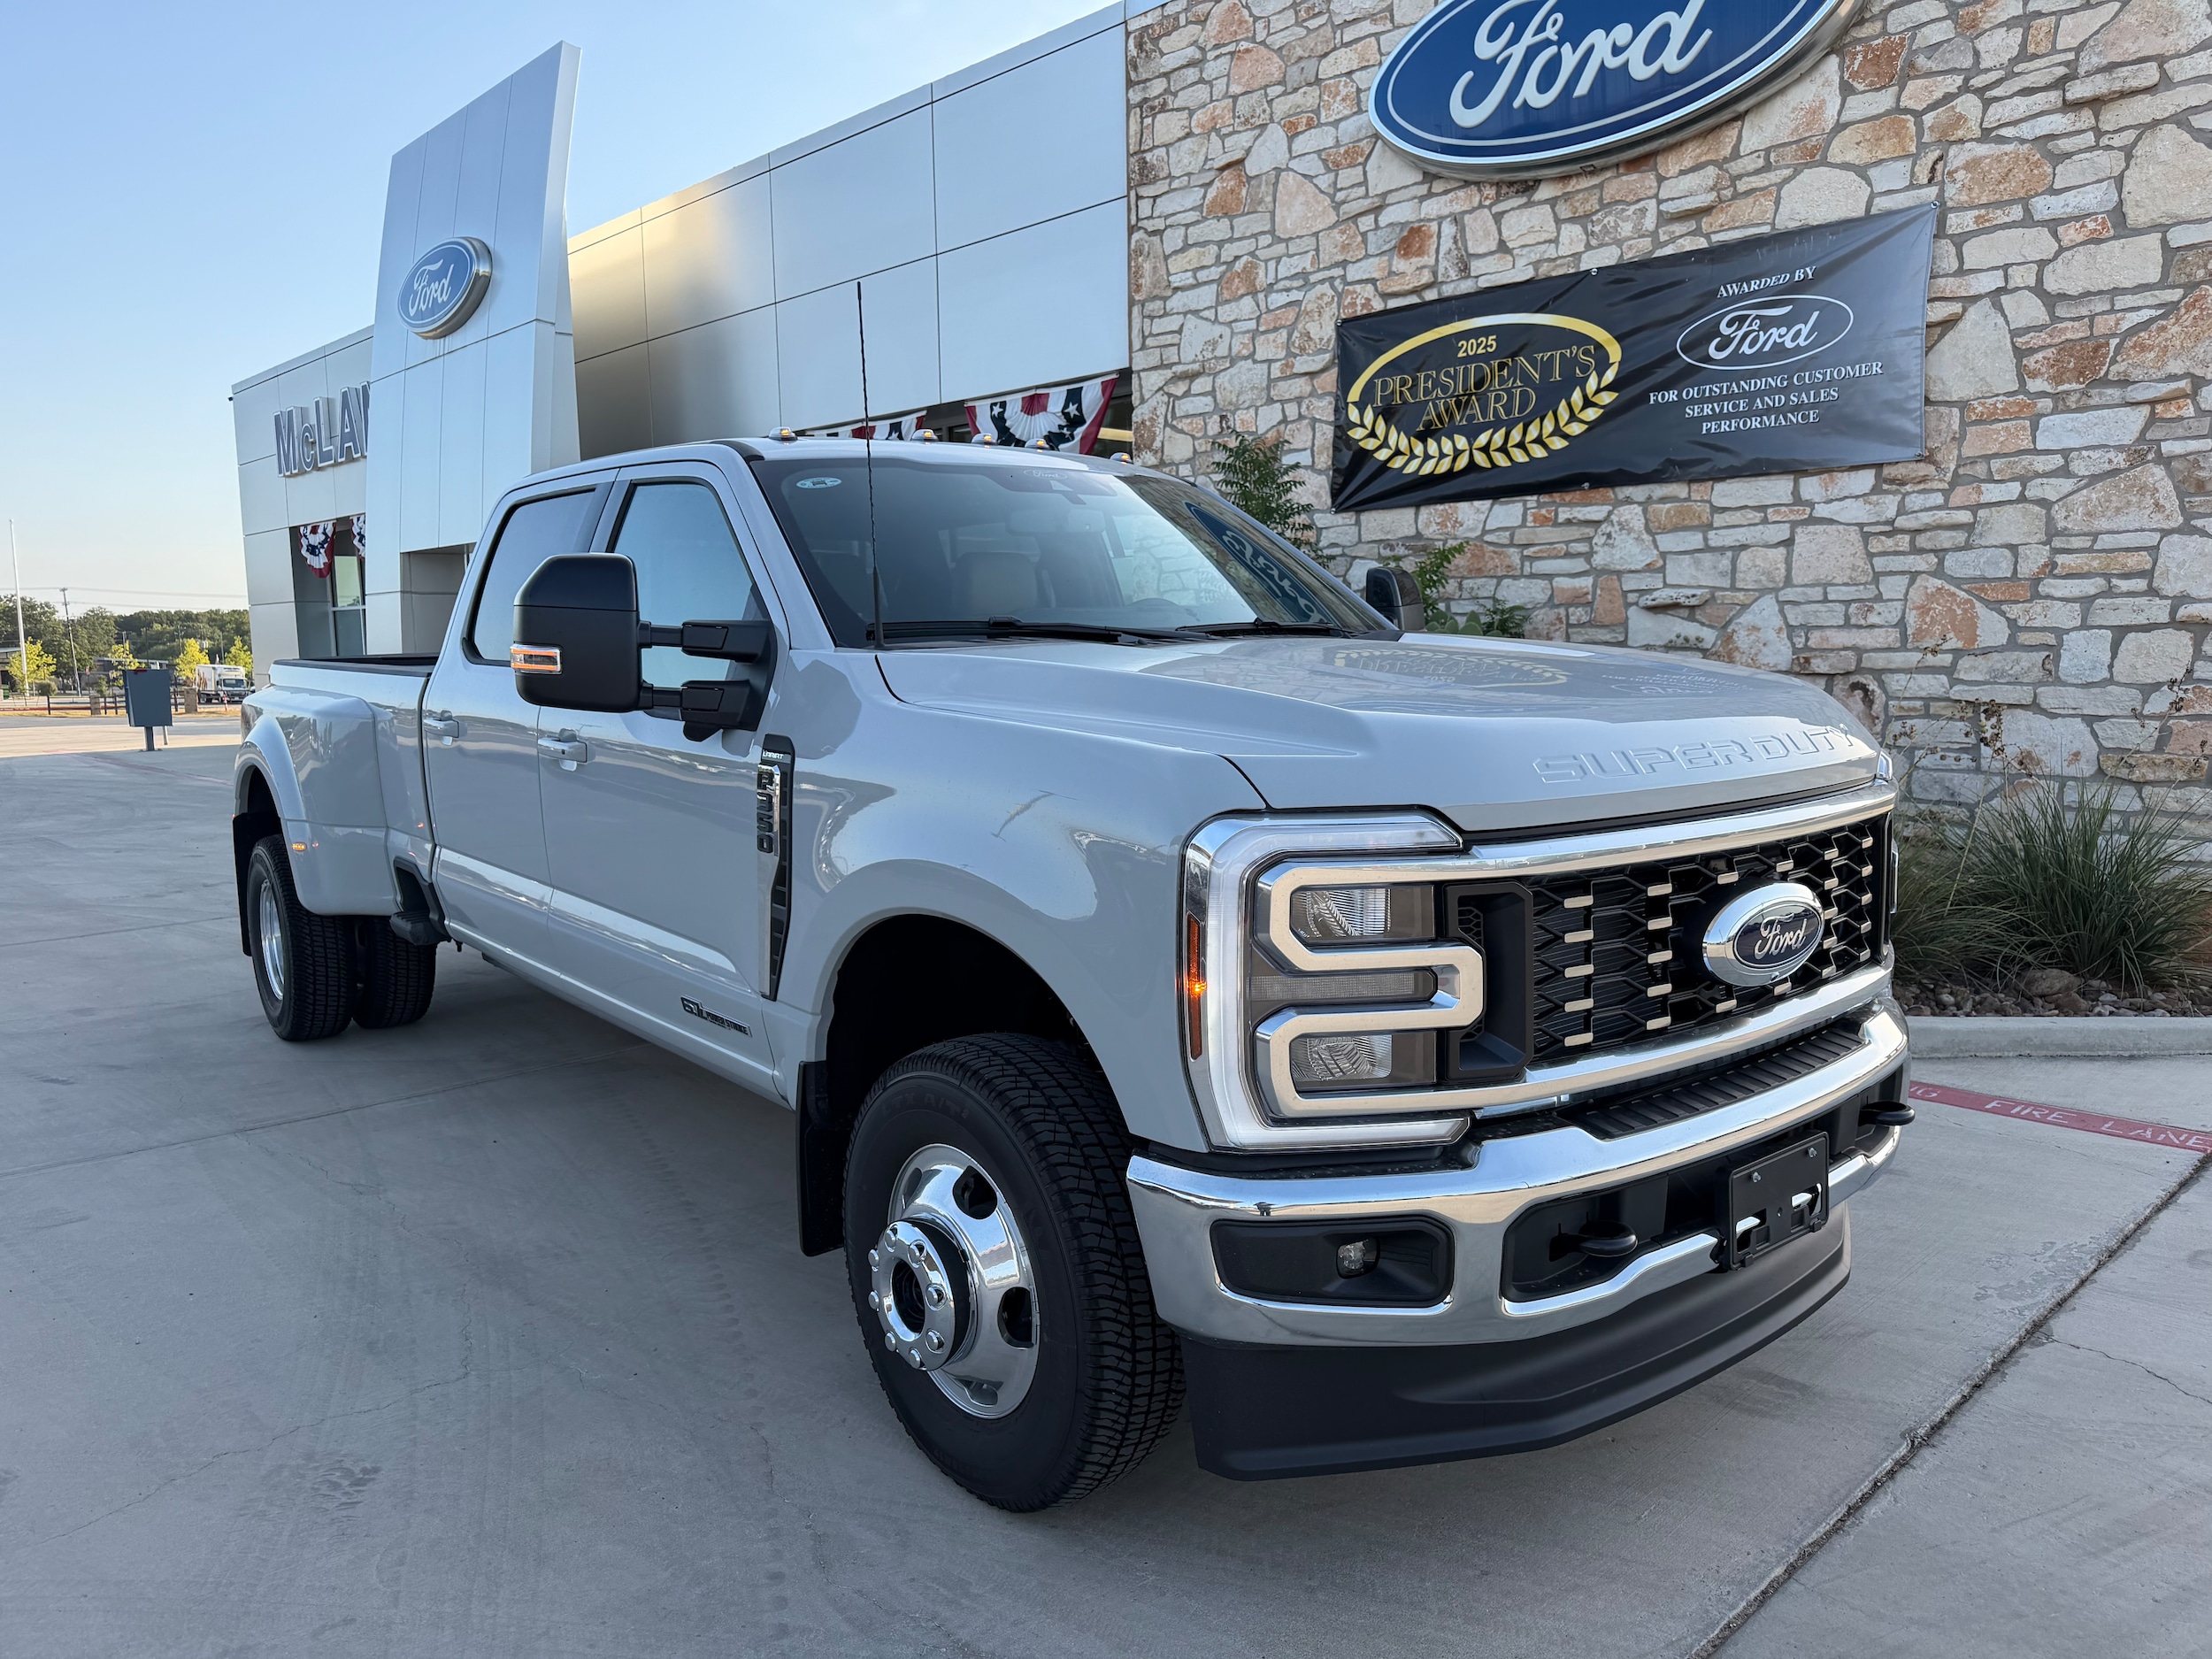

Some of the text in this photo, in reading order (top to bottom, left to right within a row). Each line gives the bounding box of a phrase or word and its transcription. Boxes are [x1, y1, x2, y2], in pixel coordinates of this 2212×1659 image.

[1449, 0, 1713, 129] Ford
[408, 258, 455, 317] Ford
[1717, 265, 1816, 298] AWARDED BY
[1456, 335, 1497, 358] 2025
[1708, 304, 1820, 360] Ford
[1371, 344, 1596, 408] PRESIDENT'S
[1648, 361, 1884, 405] FOR OUTSTANDING CUSTOMER
[1416, 387, 1537, 432] AWARD
[1685, 387, 1839, 419] SERVICE AND SALES
[1701, 409, 1820, 434] PERFORMANCE
[1532, 724, 1856, 784] SUPER DUTY
[1753, 911, 1808, 960] Ford
[1984, 1099, 2078, 1125] FIRE
[2101, 1120, 2212, 1150] LANE
